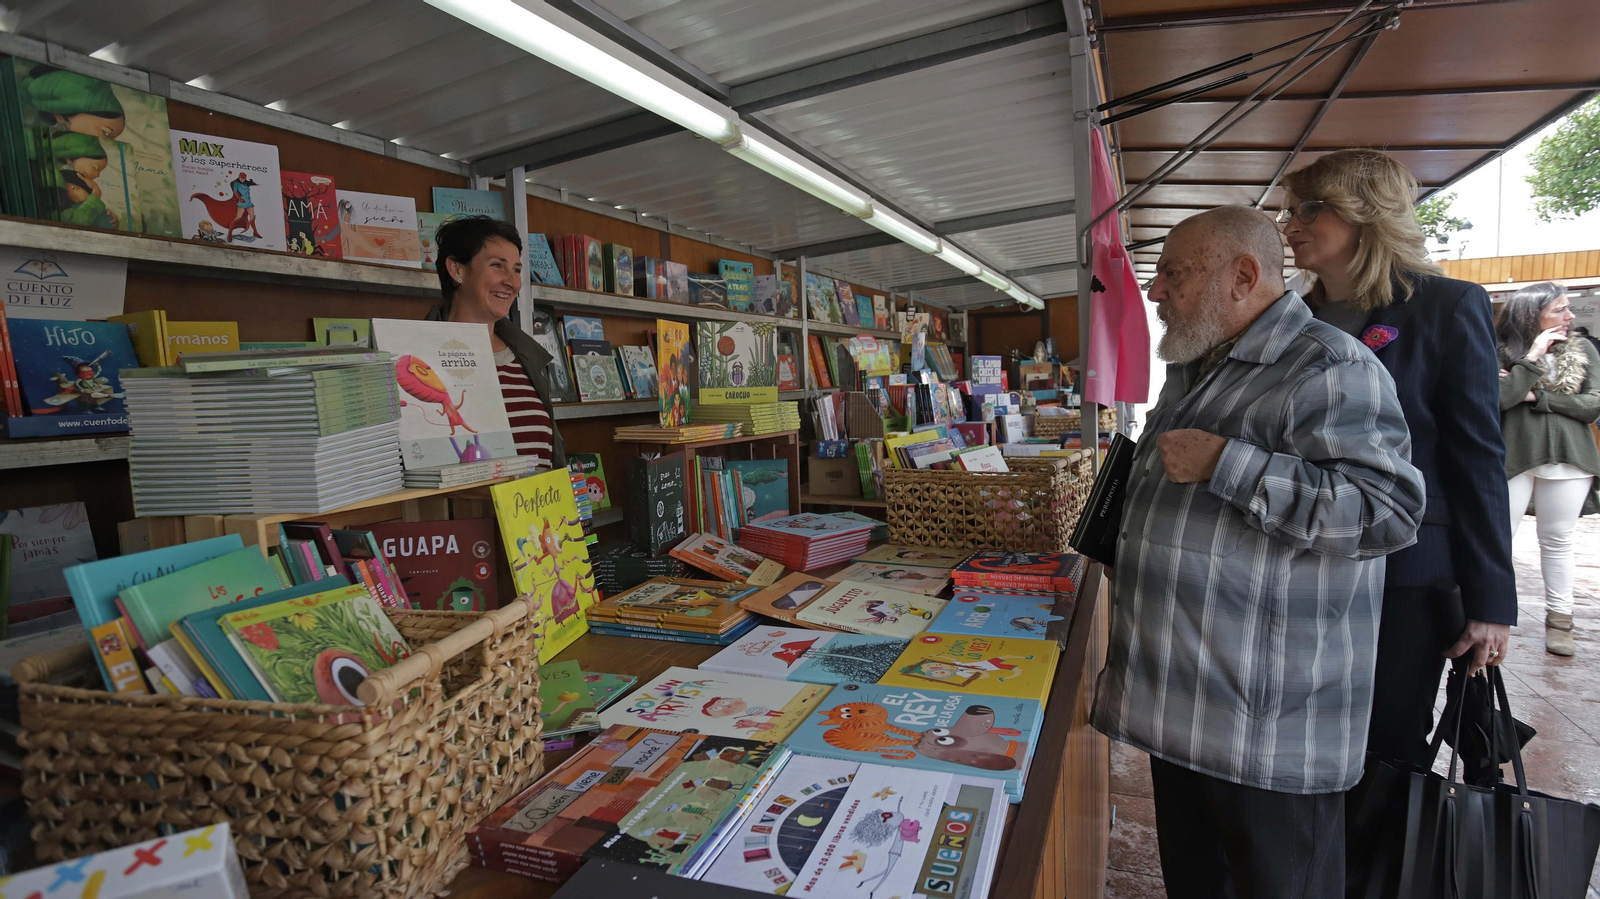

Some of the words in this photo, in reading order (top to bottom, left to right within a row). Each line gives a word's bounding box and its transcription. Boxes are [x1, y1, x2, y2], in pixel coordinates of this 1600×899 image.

[179, 138, 224, 158] MAX
[191, 156, 206, 165] los
[209, 159, 267, 173] superhéroes
[452, 200, 495, 214] Mamás
[7, 282, 73, 294] CUENTO
[8, 295, 31, 305] DE
[40, 296, 72, 308] LUZ
[441, 358, 477, 368] arriba
[448, 350, 466, 358] página
[725, 391, 750, 400] CAROCHO
[58, 416, 131, 428] www.cuentode
[513, 485, 562, 519] Perfecta
[11, 534, 29, 550] Por
[32, 534, 67, 546] siempre
[383, 534, 460, 558] GUAPA
[23, 545, 58, 562] jamás
[376, 582, 388, 604] GUAPA
[388, 594, 398, 608] GUA
[826, 588, 863, 614] JUGUETITO
[626, 693, 658, 714] SOY
[654, 679, 684, 692] UN
[638, 680, 715, 722] ARTISTA
[882, 692, 908, 706] EL
[944, 695, 963, 713] CASA
[894, 692, 943, 726] REY
[942, 711, 950, 719] LA
[934, 718, 946, 728] DE
[633, 738, 670, 766] noche?
[573, 770, 601, 792] viene
[607, 768, 626, 786] esta
[510, 793, 570, 832] ¿Quién
[602, 834, 622, 849] Más
[620, 826, 629, 836] de
[648, 792, 666, 810] libros
[662, 772, 688, 794] vendidos
[843, 800, 861, 824] vendidos
[831, 826, 847, 844] libros
[818, 844, 836, 867] 20.000
[814, 868, 824, 876] de
[804, 876, 818, 892] Más
